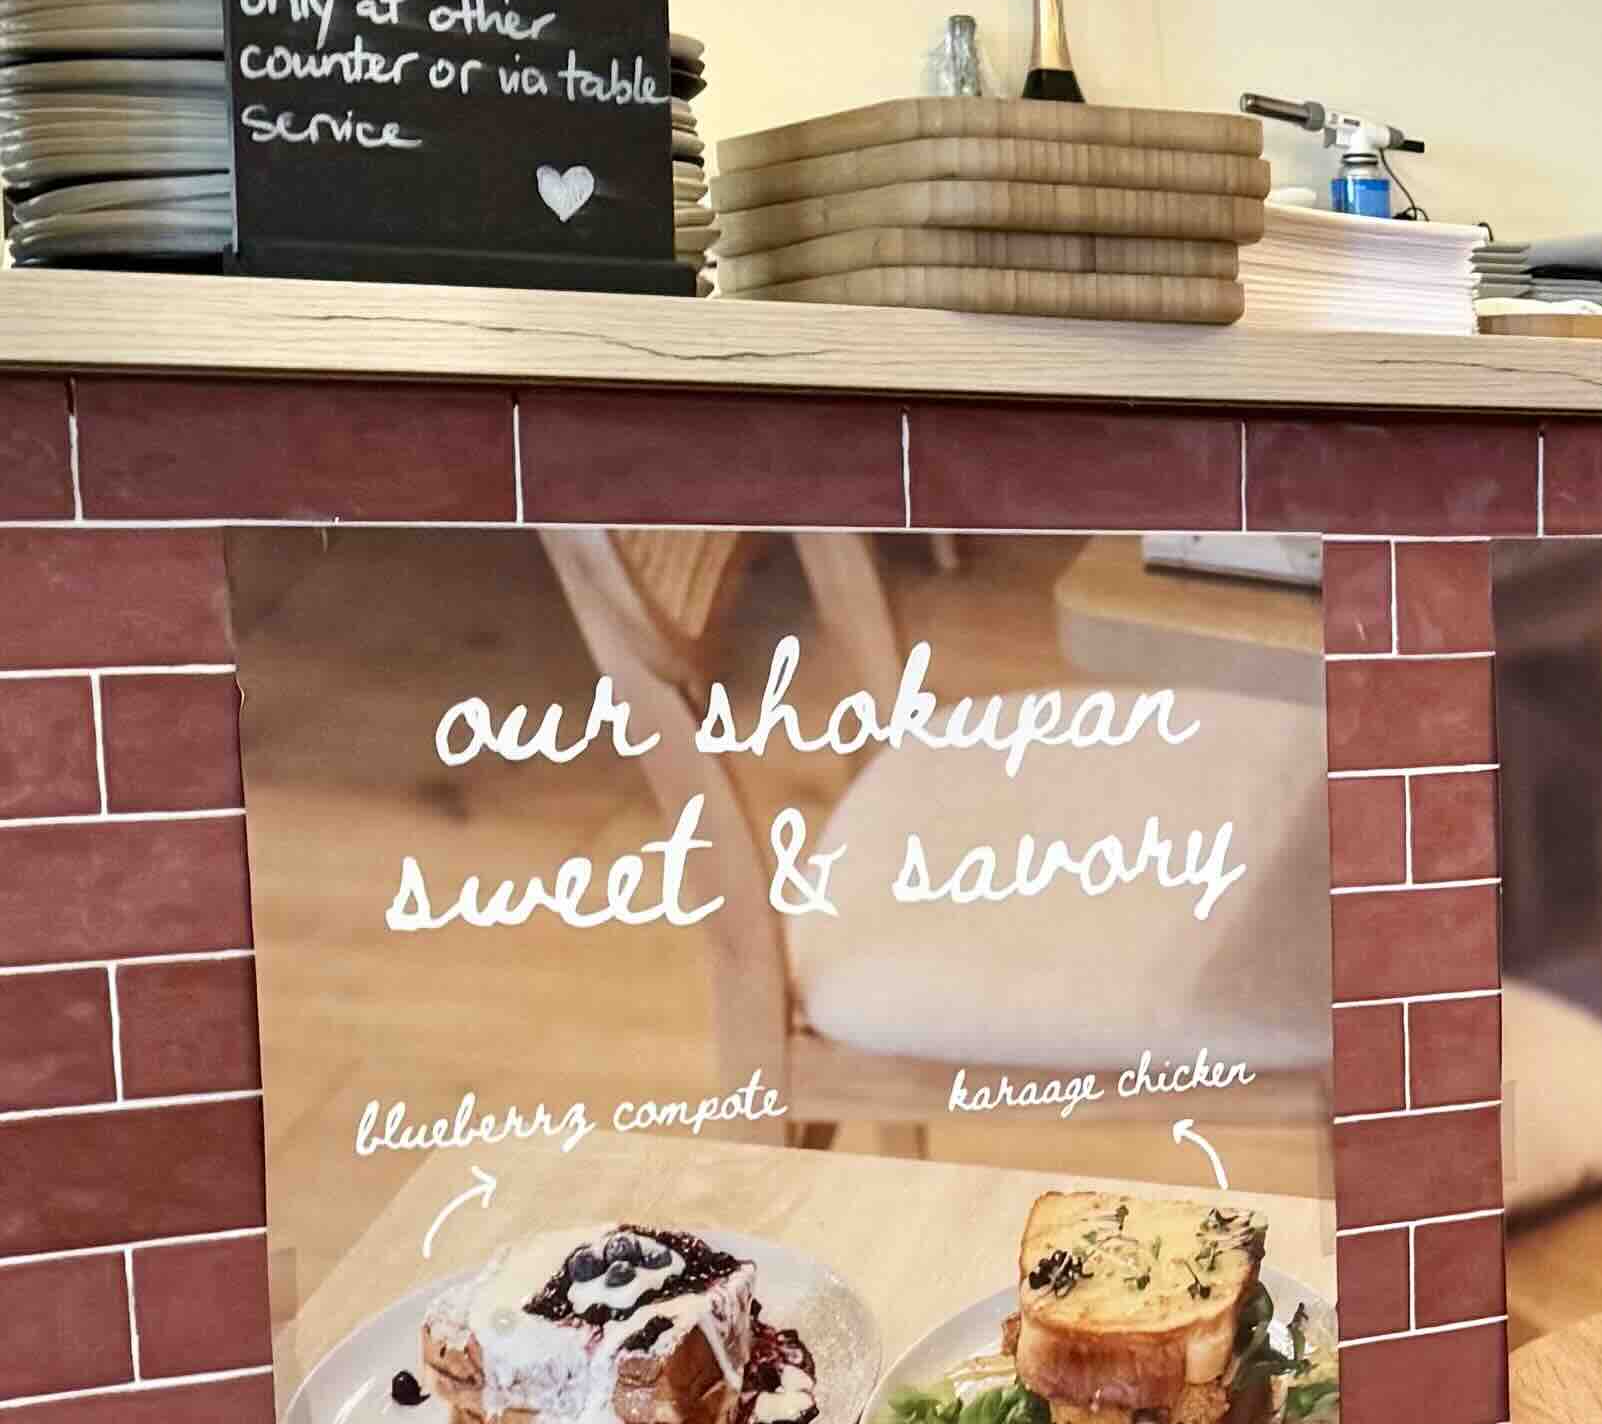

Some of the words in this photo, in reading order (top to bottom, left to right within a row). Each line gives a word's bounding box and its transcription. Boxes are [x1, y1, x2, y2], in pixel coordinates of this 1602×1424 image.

[240, 37, 419, 86] counter
[429, 56, 481, 93] or
[499, 53, 548, 96] via
[559, 49, 672, 105] table
[241, 105, 423, 149] service
[435, 675, 660, 766] our
[695, 635, 1200, 776] shokupan
[385, 793, 726, 931] sweet
[769, 807, 848, 917] &
[892, 816, 1247, 921] savory
[613, 1068, 789, 1141] compote
[948, 1069, 1105, 1118] karaage
[1117, 1047, 1256, 1097] chicken
